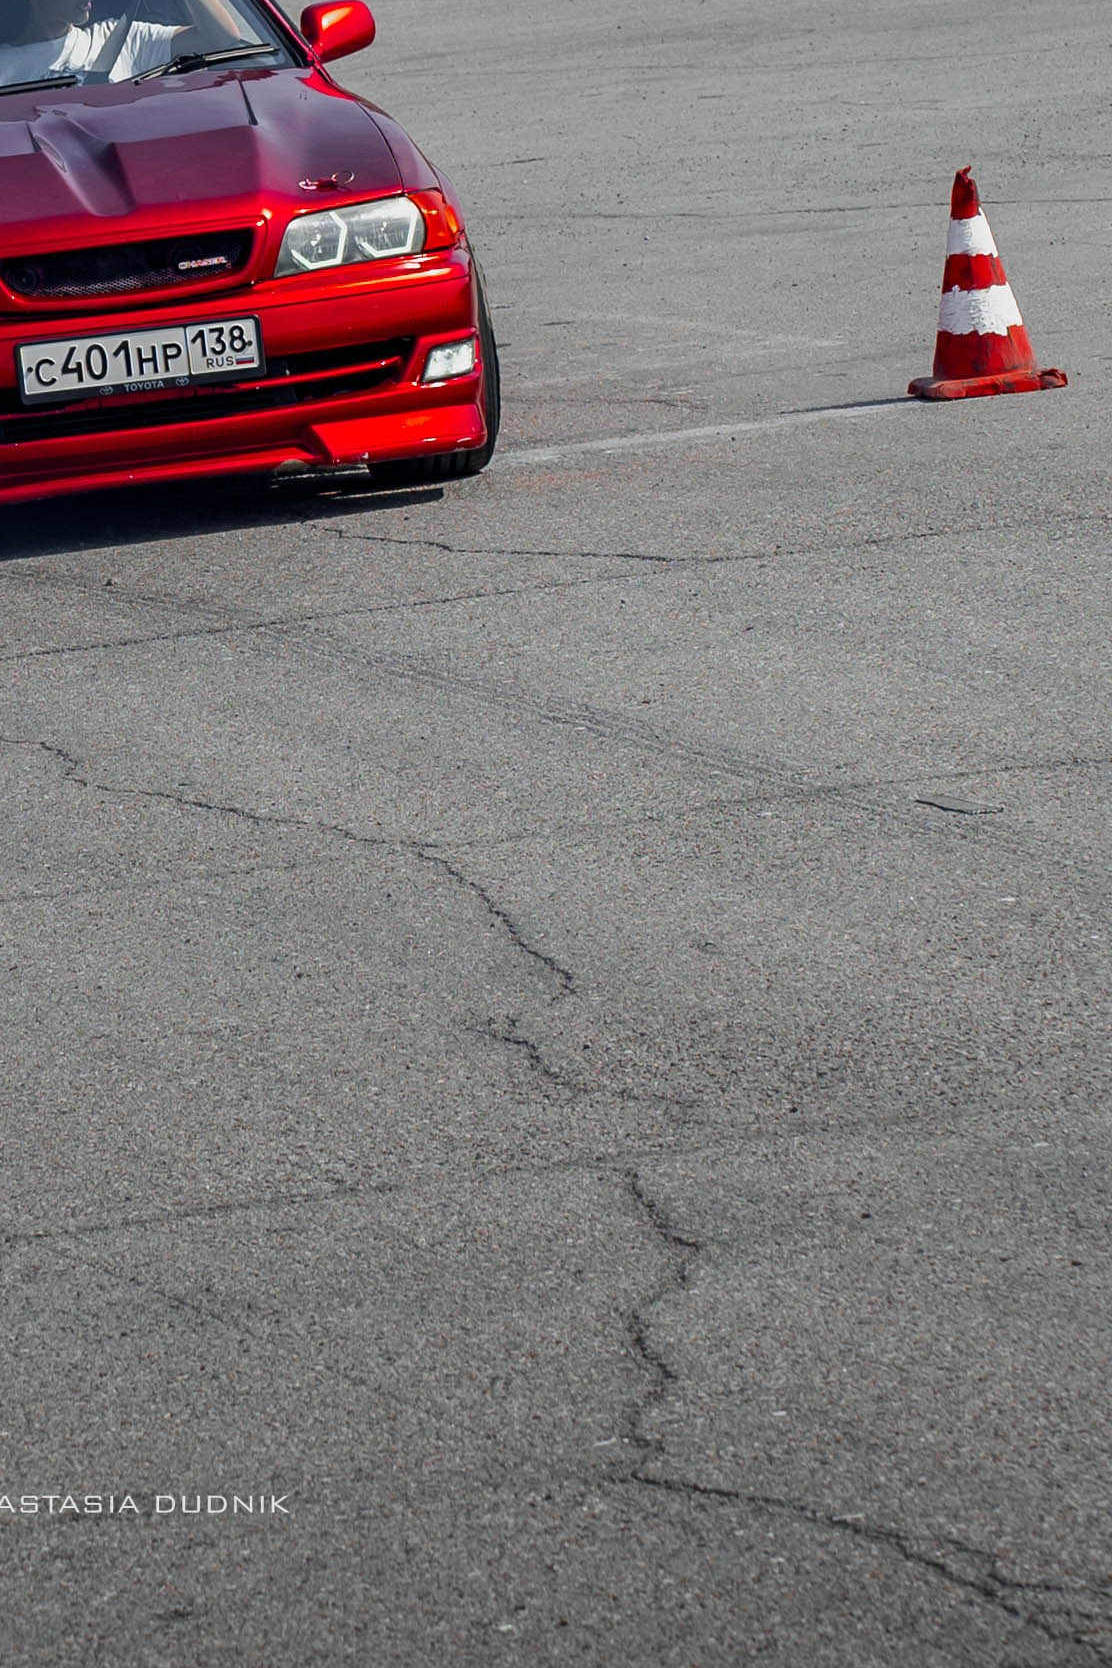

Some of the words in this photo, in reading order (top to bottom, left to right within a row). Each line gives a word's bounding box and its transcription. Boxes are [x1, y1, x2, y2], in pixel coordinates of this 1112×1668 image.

[191, 324, 247, 357] 138
[206, 355, 234, 369] RUS
[124, 380, 165, 392] TOYOTA
